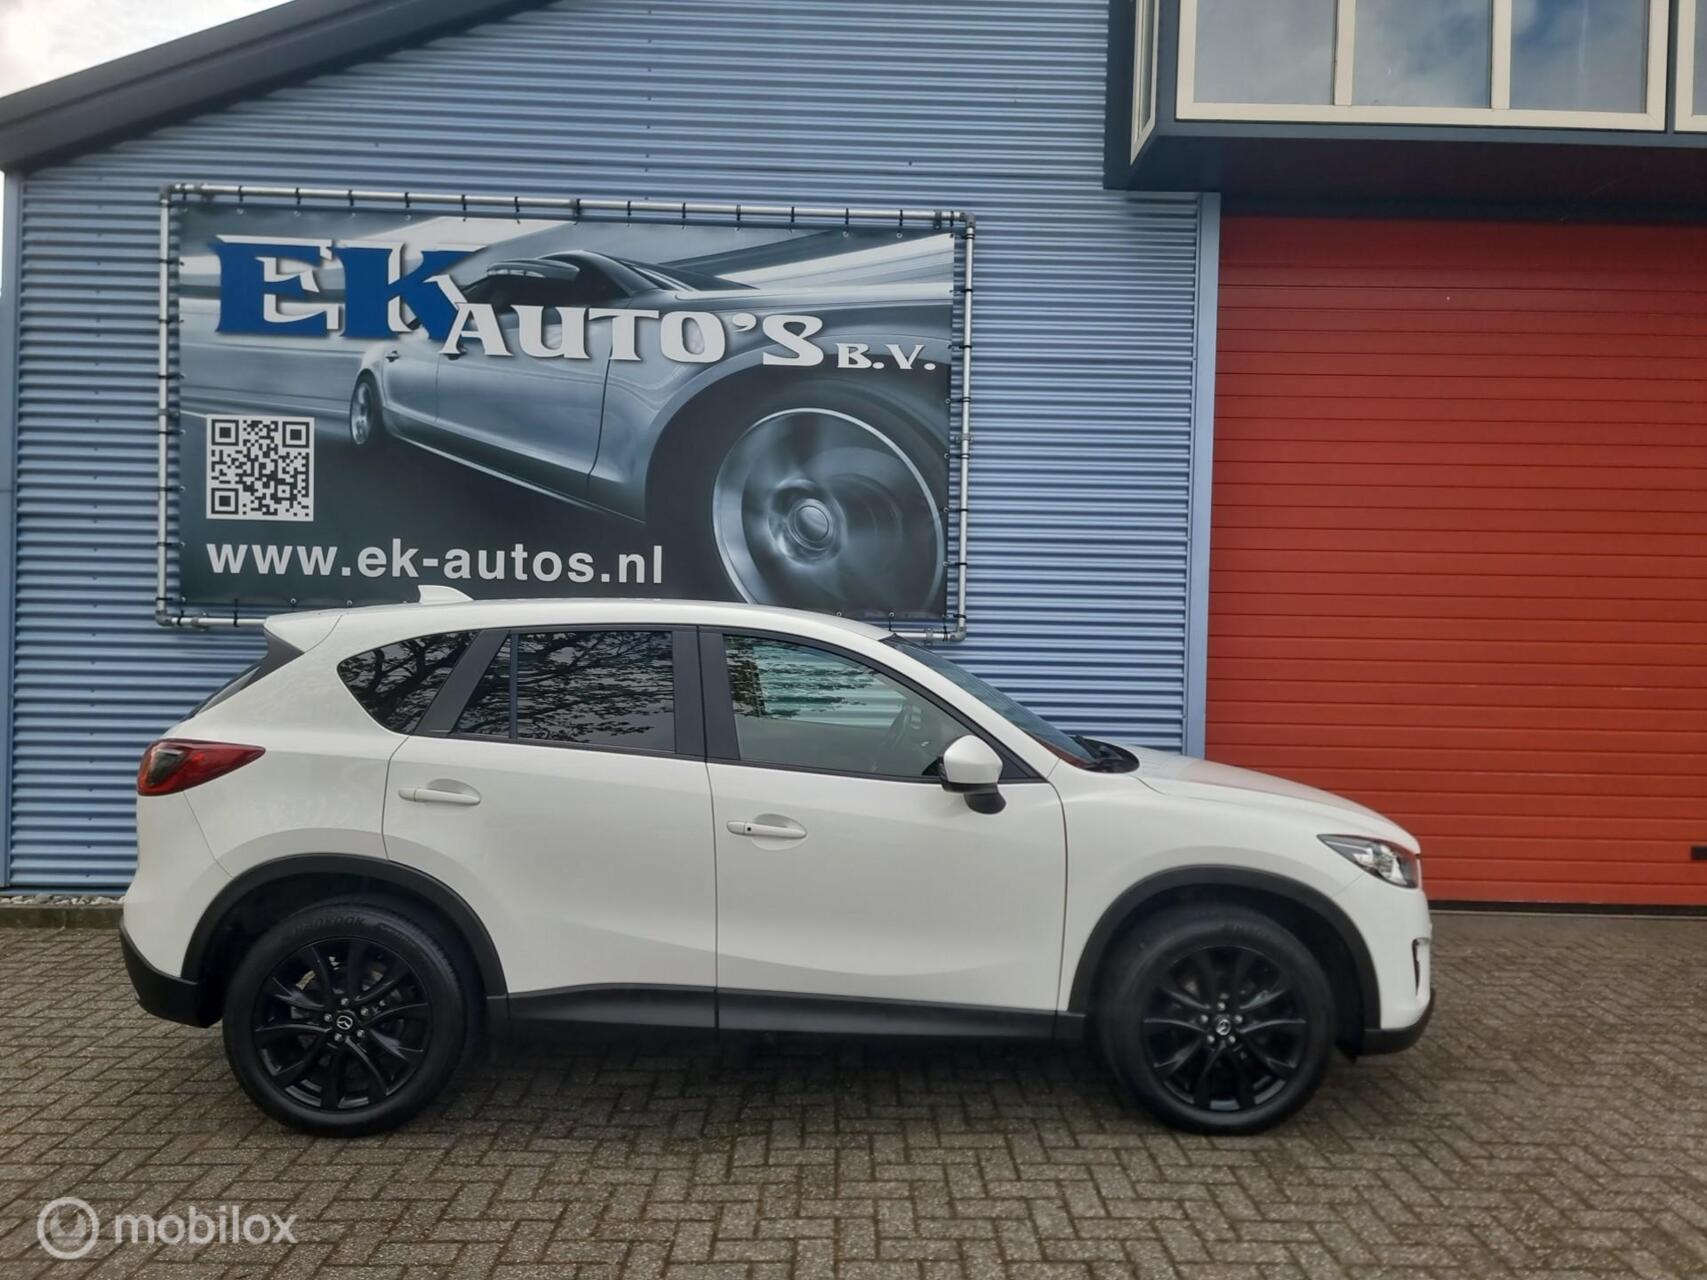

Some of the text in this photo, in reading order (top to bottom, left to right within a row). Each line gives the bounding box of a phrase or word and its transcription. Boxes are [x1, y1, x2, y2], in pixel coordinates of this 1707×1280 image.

[212, 234, 487, 341] EK
[835, 342, 936, 370] B.V.
[206, 538, 662, 584] www.ek-autos.nl
